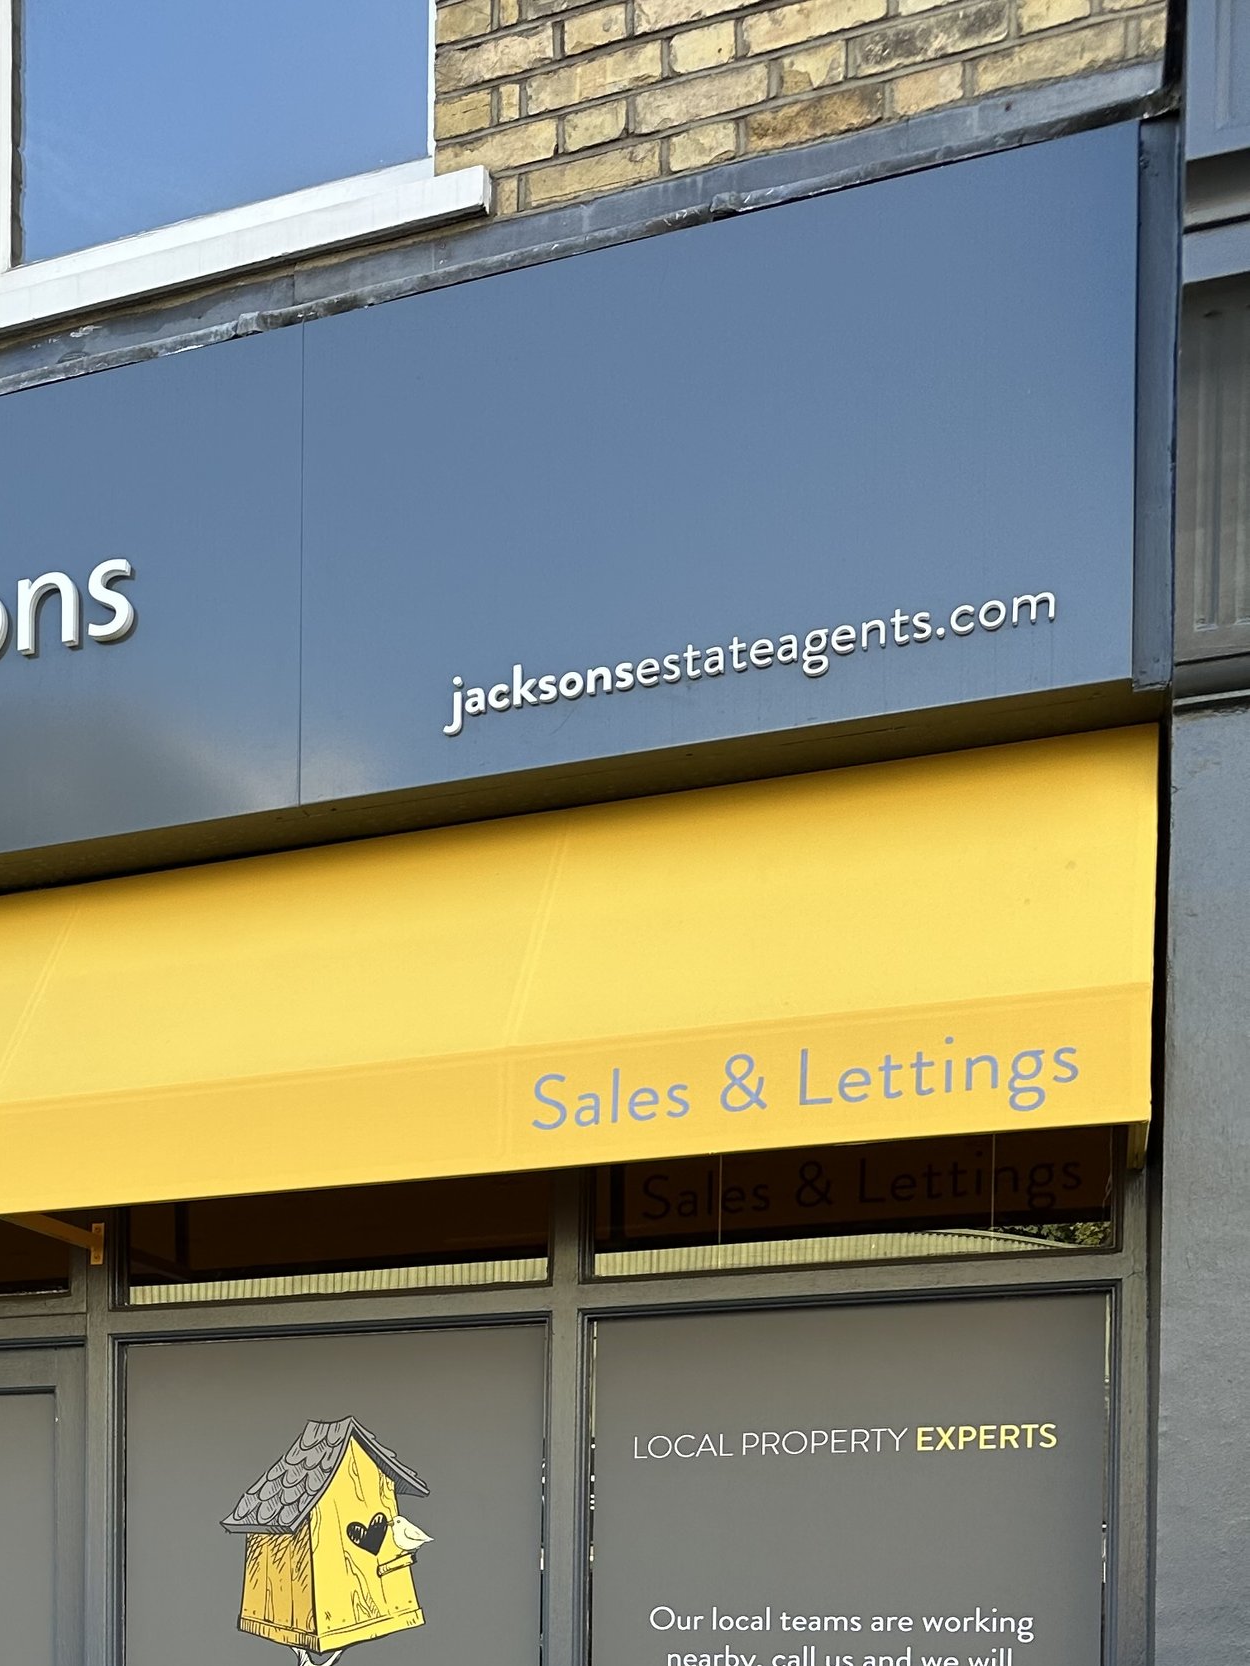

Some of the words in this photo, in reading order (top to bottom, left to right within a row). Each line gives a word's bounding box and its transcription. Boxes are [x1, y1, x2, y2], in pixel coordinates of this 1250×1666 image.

[442, 590, 1056, 736] jacksonsestateagents.com
[532, 1067, 690, 1130] Sales
[719, 1053, 768, 1113] &
[798, 1036, 1080, 1111] Lettings
[642, 1173, 771, 1220] Sales
[795, 1160, 833, 1207] &
[859, 1151, 1084, 1210] Lettings
[634, 1434, 734, 1459] LOCAL
[743, 1428, 908, 1455] PROPERTY
[917, 1424, 1057, 1451] EXPERTS
[650, 1606, 704, 1630] Our
[713, 1607, 770, 1631] local
[780, 1612, 861, 1631] teams
[871, 1617, 913, 1632] are
[922, 1607, 1034, 1643] working
